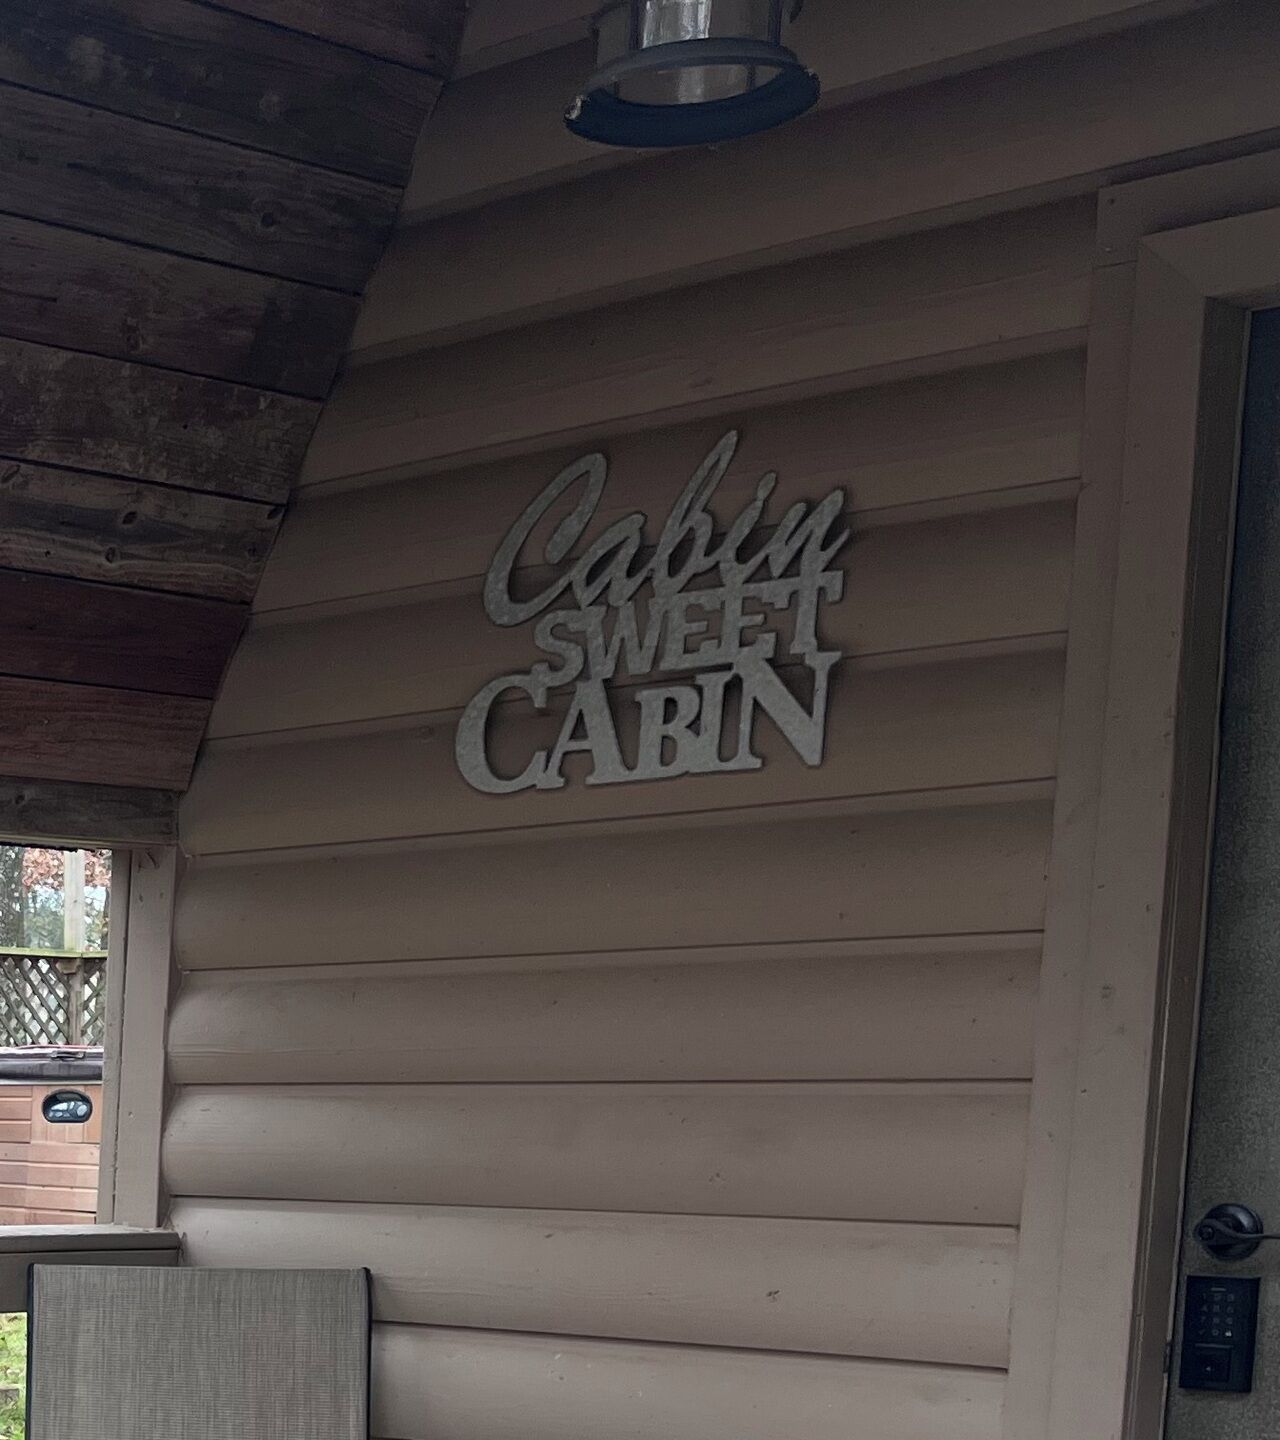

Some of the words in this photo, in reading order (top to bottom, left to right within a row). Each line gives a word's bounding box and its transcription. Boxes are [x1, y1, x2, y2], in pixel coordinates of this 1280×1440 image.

[483, 429, 851, 627] Cabin
[533, 569, 845, 688] SWEET
[454, 650, 843, 794] CABIN
